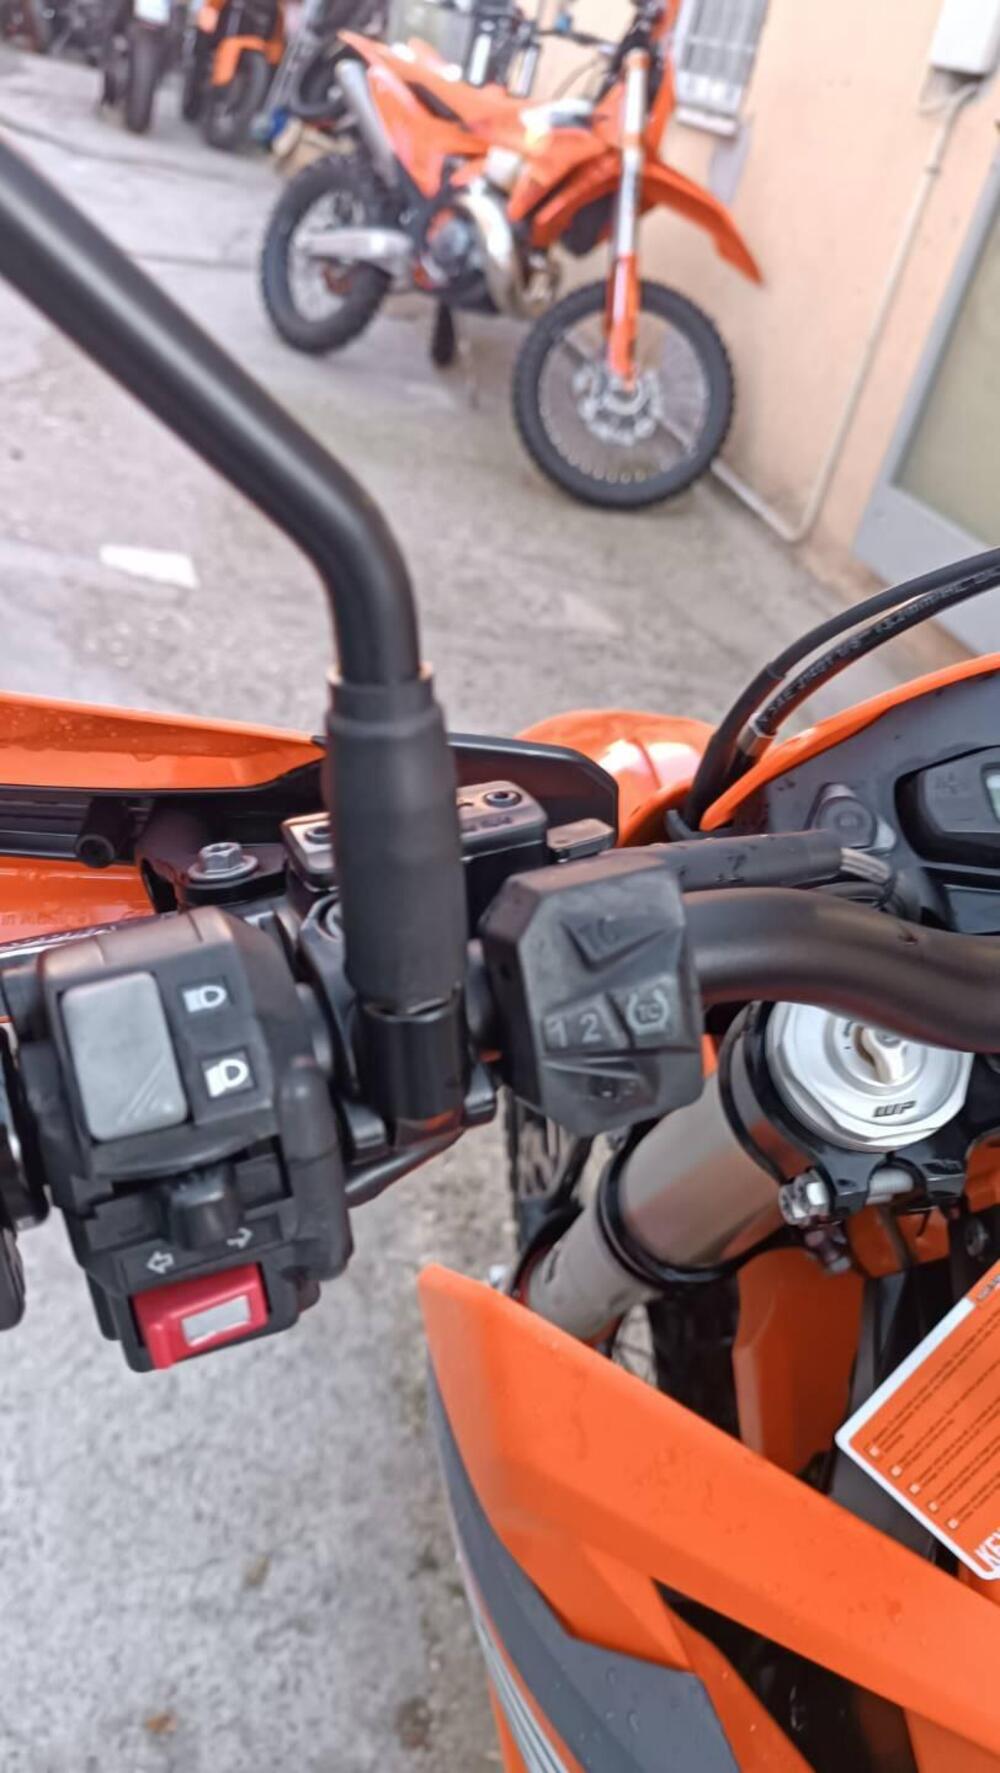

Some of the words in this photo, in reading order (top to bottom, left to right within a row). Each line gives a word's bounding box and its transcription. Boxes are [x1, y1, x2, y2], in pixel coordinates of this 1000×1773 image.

[546, 1018, 567, 1047] 1
[579, 1013, 602, 1042] 2
[873, 1100, 917, 1118] WP
